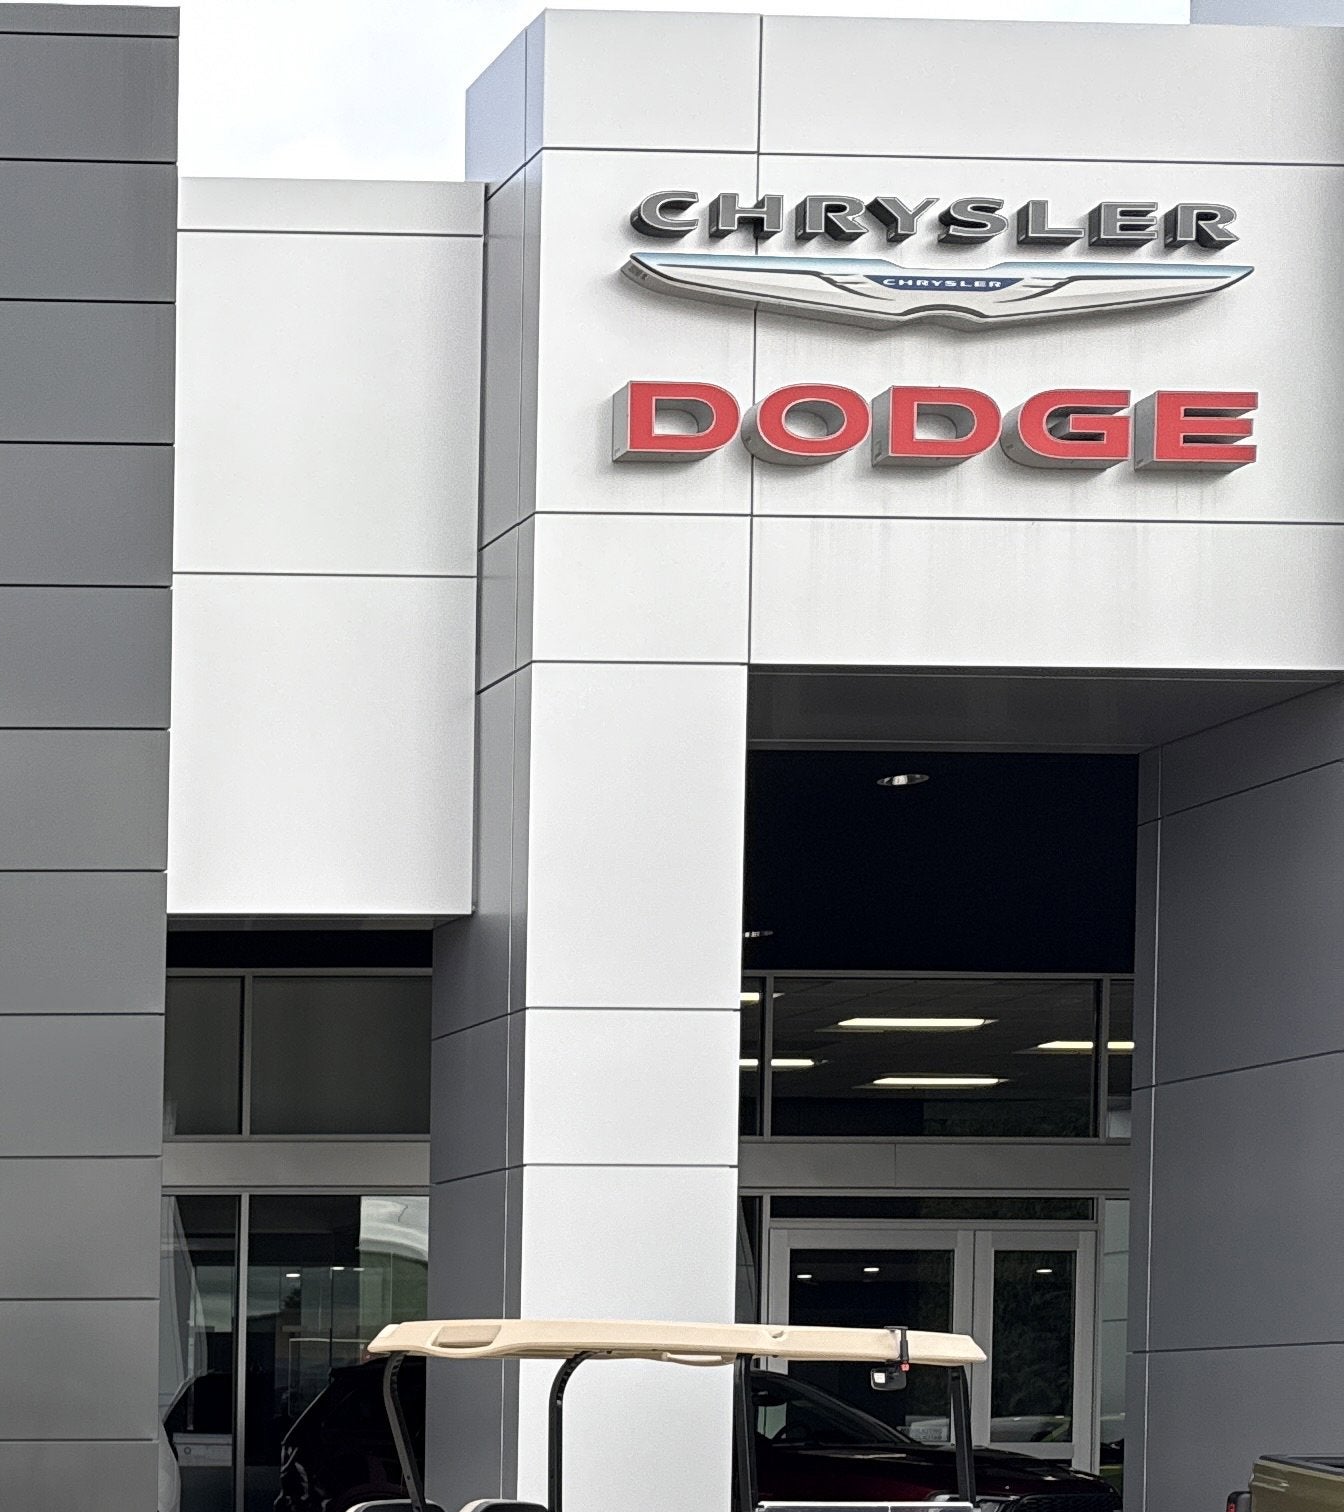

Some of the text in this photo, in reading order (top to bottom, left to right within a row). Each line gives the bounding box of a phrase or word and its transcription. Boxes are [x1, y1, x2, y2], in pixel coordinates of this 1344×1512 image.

[630, 190, 1240, 250] CHRYSLER
[882, 278, 1002, 288] CHRYSLER
[613, 380, 1259, 470] DODGE
